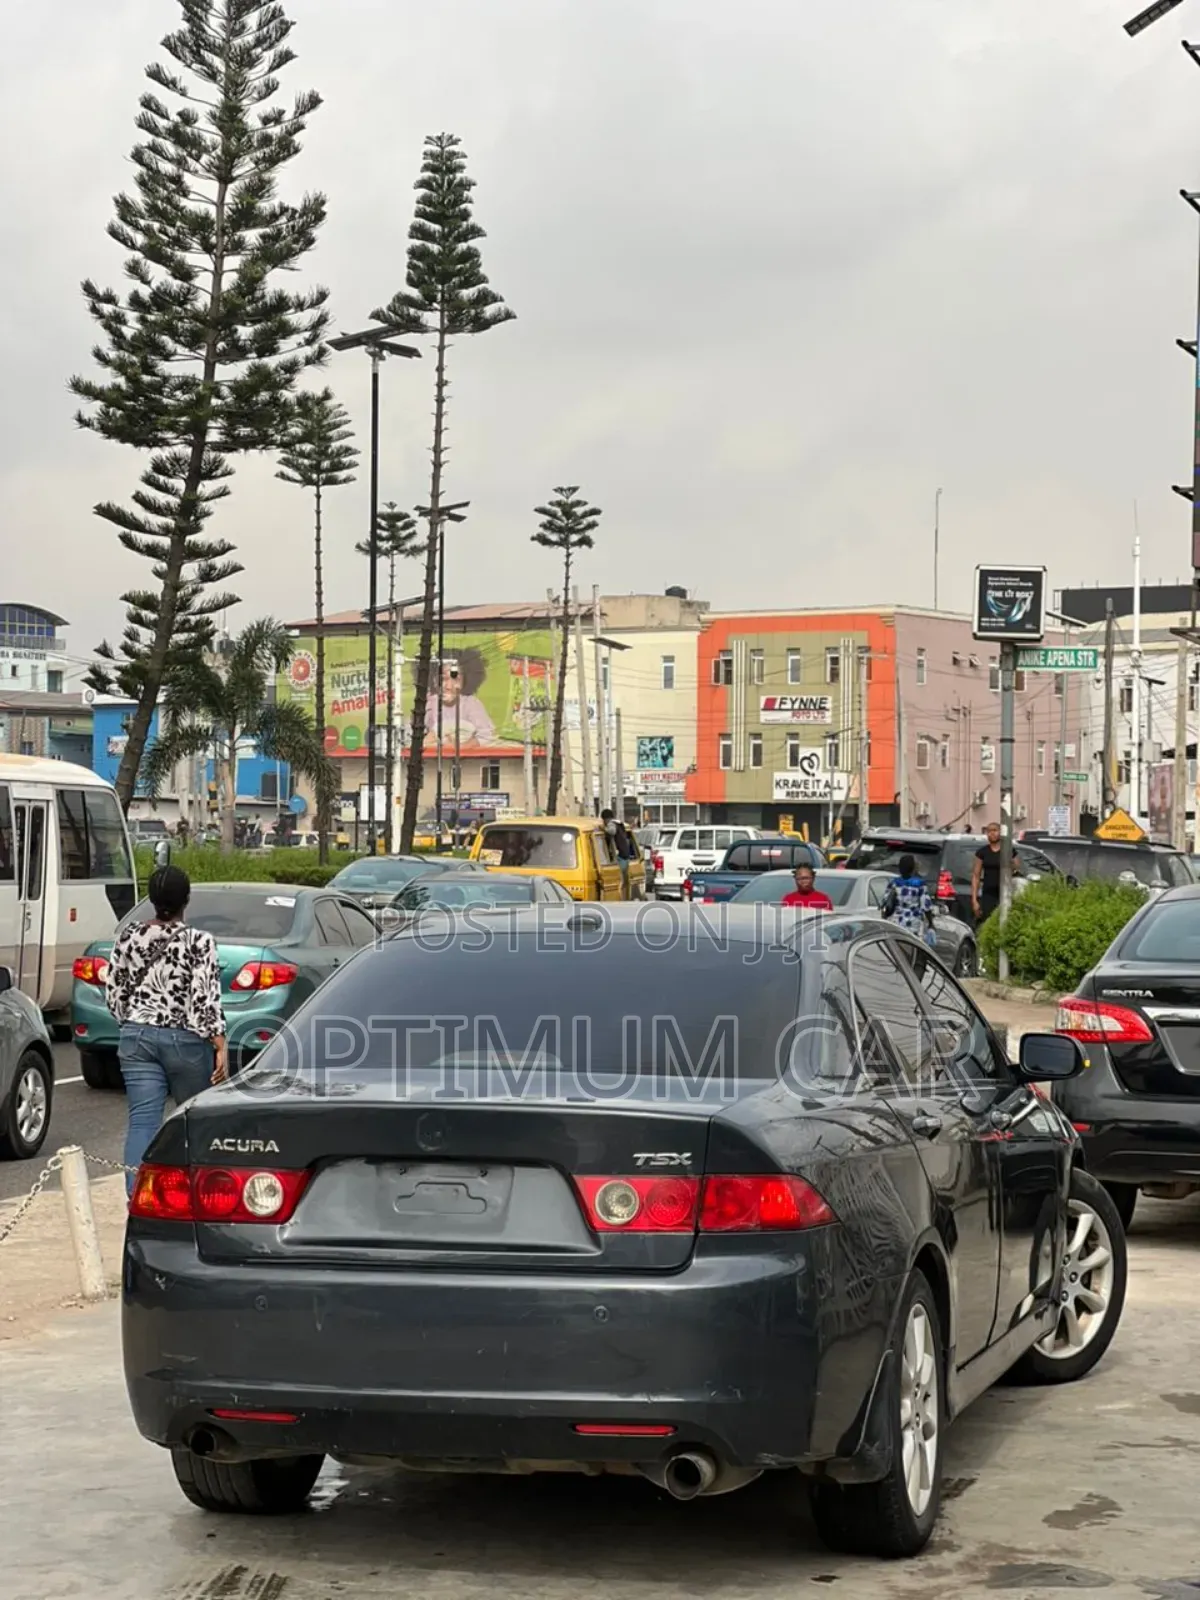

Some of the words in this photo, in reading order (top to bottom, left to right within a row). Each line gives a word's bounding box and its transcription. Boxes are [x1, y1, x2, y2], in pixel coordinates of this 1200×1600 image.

[1018, 649, 1046, 667] ANIKE
[1046, 648, 1077, 667] APENA
[1077, 648, 1096, 667] STR
[331, 665, 386, 688] Nurtue
[779, 697, 829, 710] FYNNE
[775, 779, 811, 790] KRAVE
[812, 779, 821, 790] IT
[1102, 989, 1154, 998] SENTRA
[209, 1138, 280, 1154] ACURA
[632, 1152, 692, 1166] TSX
